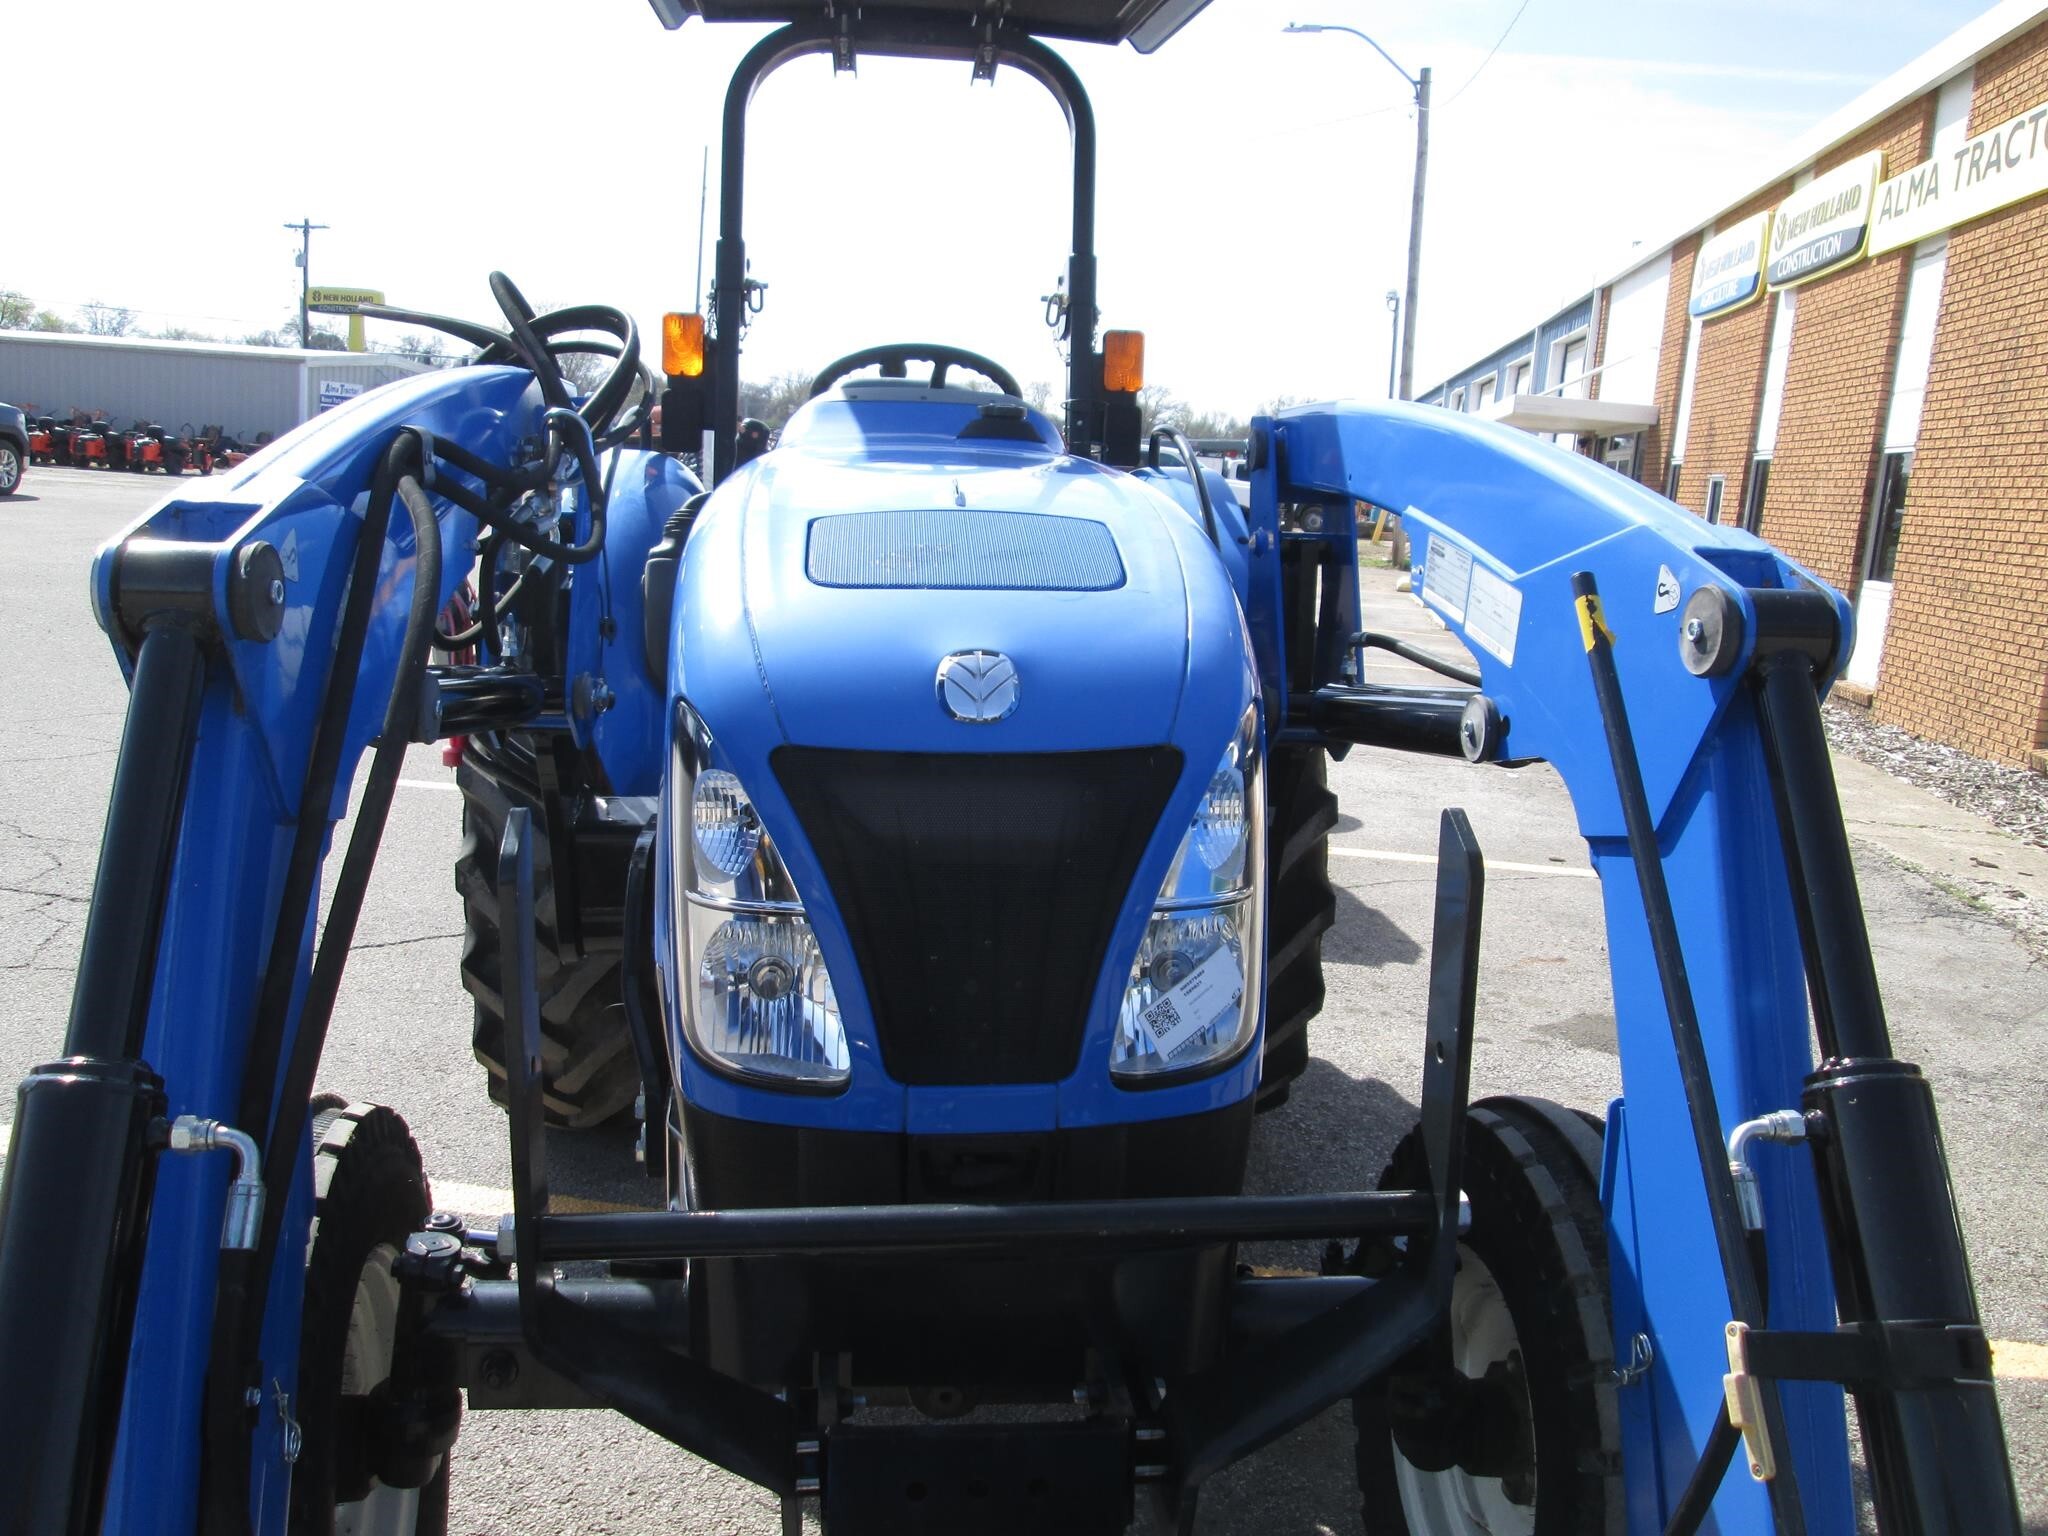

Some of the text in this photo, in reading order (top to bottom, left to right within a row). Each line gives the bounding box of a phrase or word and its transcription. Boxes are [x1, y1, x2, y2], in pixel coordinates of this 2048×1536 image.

[1786, 184, 1862, 241] NEW HOLLAND
[1877, 162, 1939, 225] ALMA
[1777, 232, 1843, 278] CONSTRUCTION
[323, 293, 374, 304] NEW HOLLAND
